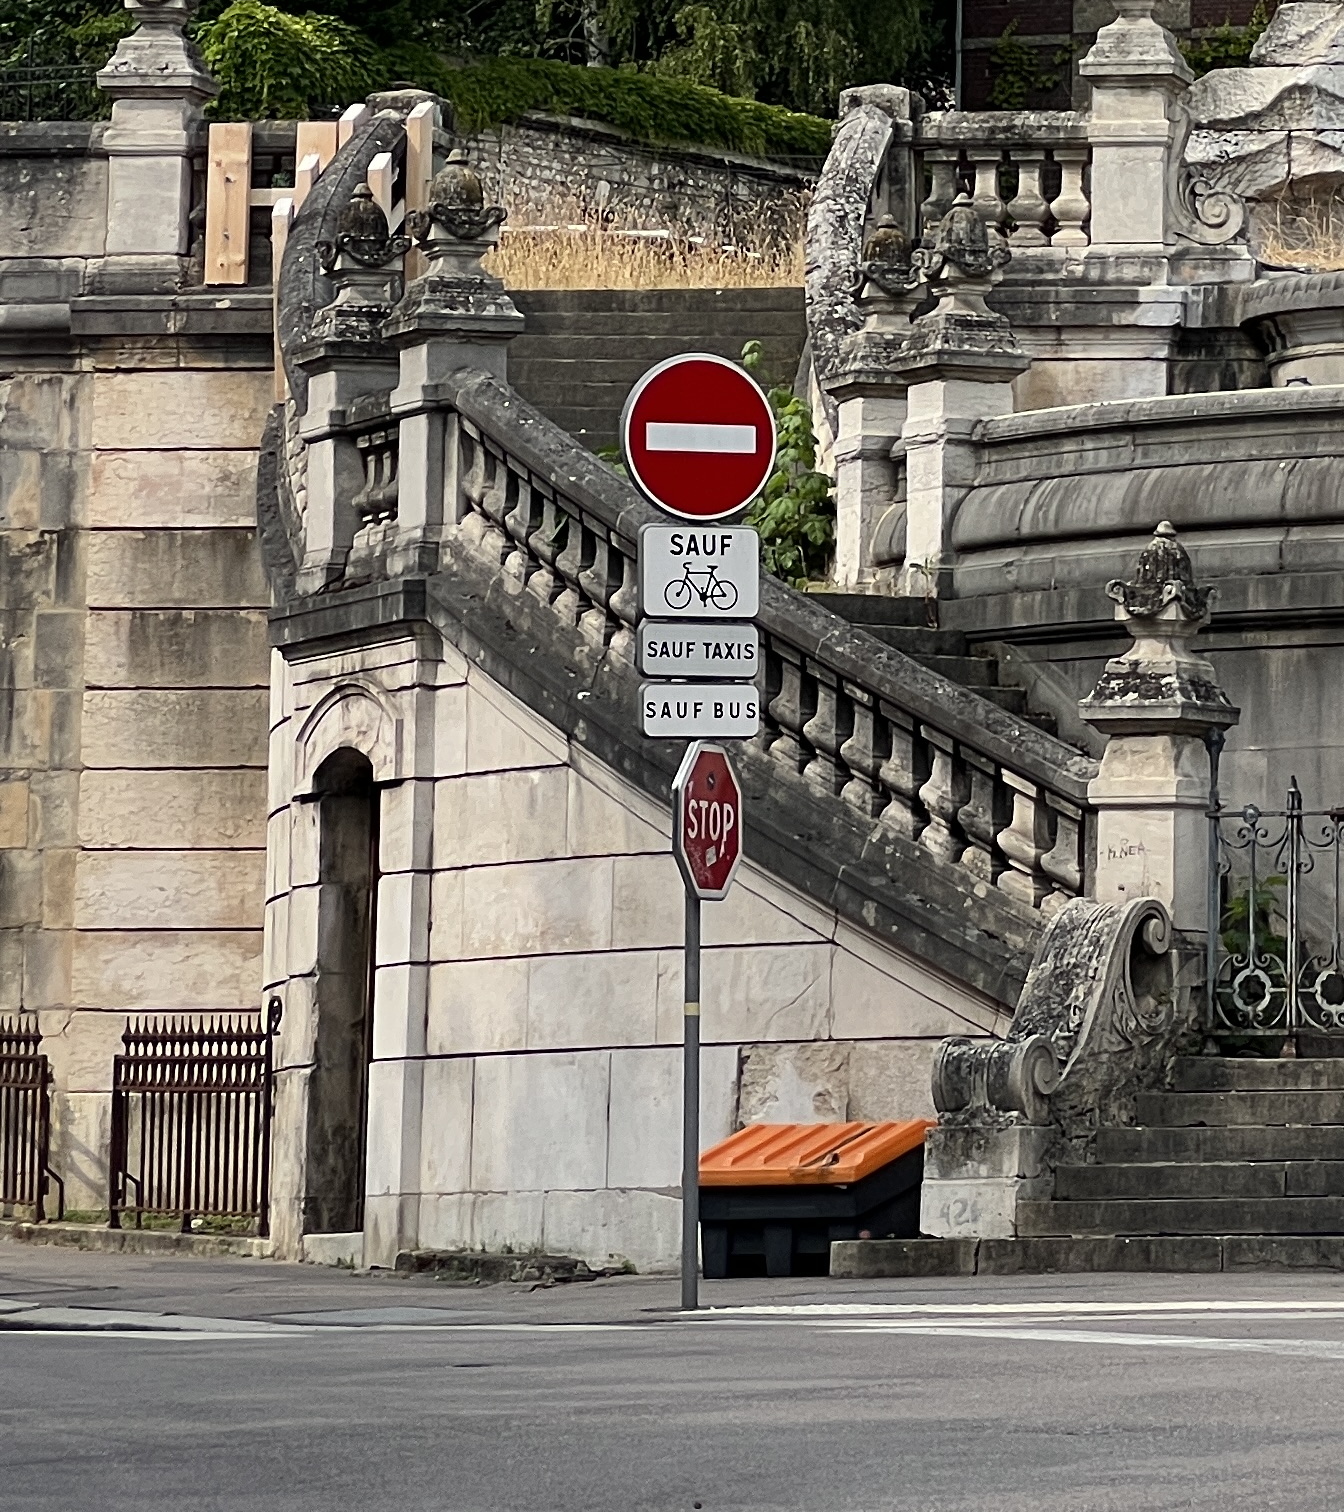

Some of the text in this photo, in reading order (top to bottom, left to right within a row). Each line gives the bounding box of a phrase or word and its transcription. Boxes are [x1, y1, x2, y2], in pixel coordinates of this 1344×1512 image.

[670, 534, 733, 556] SAUF
[647, 641, 755, 660] SAUF TAXIS
[645, 701, 757, 719] SAUF BUS
[687, 799, 734, 842] STOP
